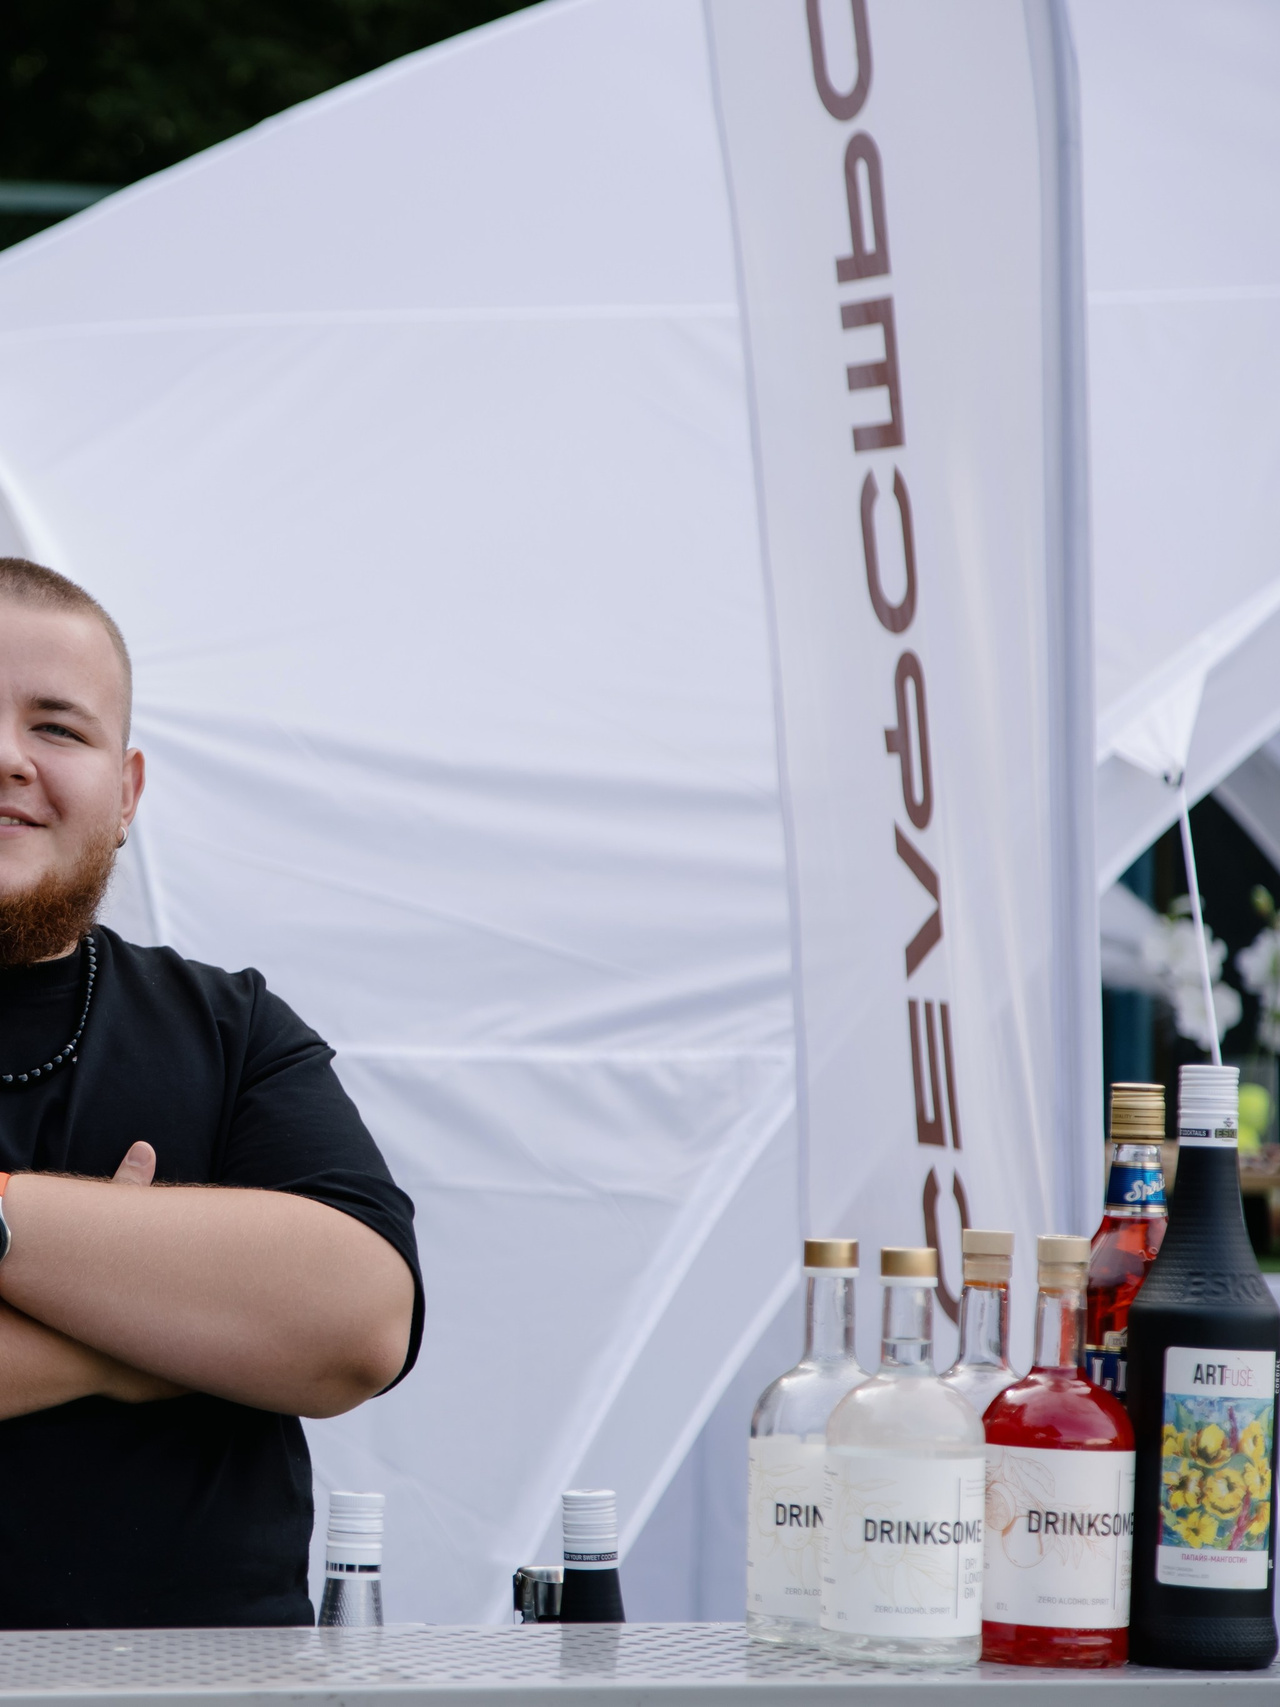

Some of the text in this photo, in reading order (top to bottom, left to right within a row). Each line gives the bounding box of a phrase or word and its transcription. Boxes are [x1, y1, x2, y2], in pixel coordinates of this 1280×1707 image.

[775, 1503, 825, 1529] DRIN
[1028, 1510, 1135, 1537] DRINKSOME
[864, 1518, 982, 1545] DRINKSOME
[1181, 1553, 1248, 1564] ПАПАЙЯ-МАНГОСТИН
[785, 1587, 822, 1597] ZERO ALCO
[1037, 1595, 1110, 1606] ZERO ALCOHOL SPIRIT
[874, 1604, 951, 1615] ZERO ALCOHOL SPIRIT
